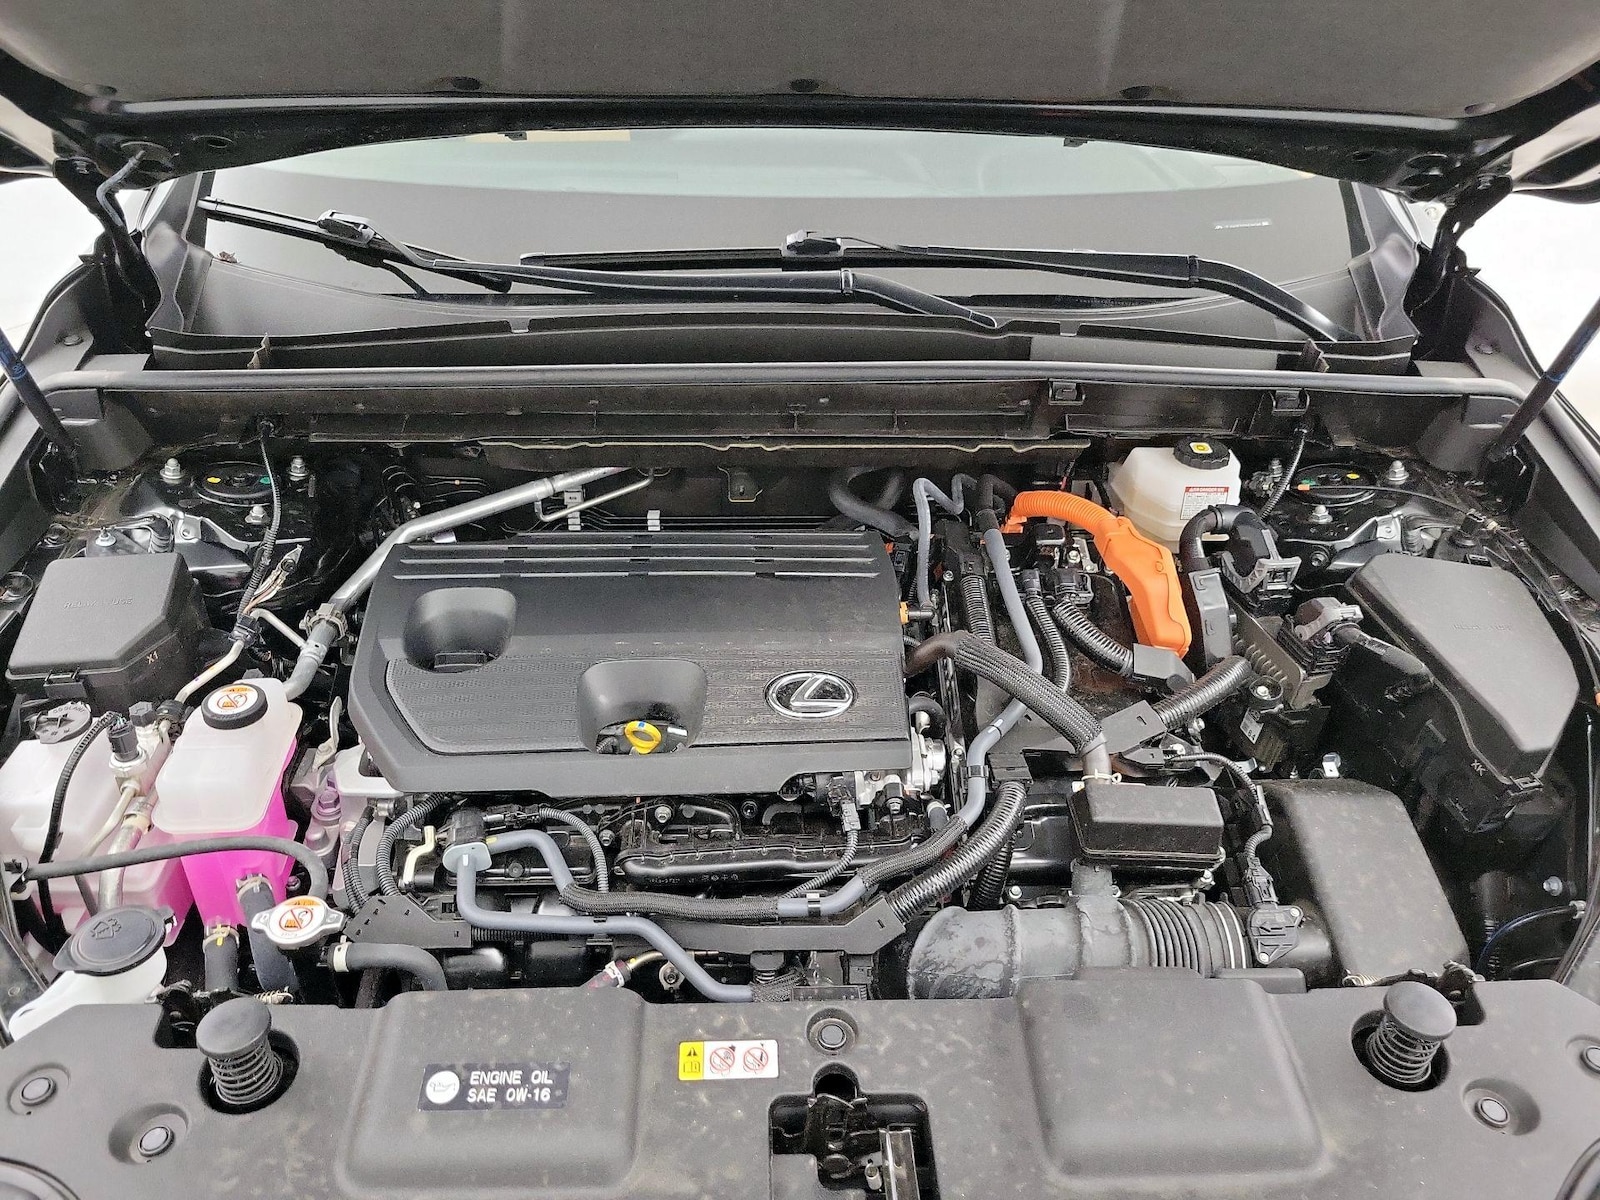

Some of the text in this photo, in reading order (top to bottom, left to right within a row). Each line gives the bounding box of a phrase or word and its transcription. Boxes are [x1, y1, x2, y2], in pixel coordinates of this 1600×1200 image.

[469, 1070, 553, 1085] ENGINE OIL
[466, 1088, 498, 1103] SAE
